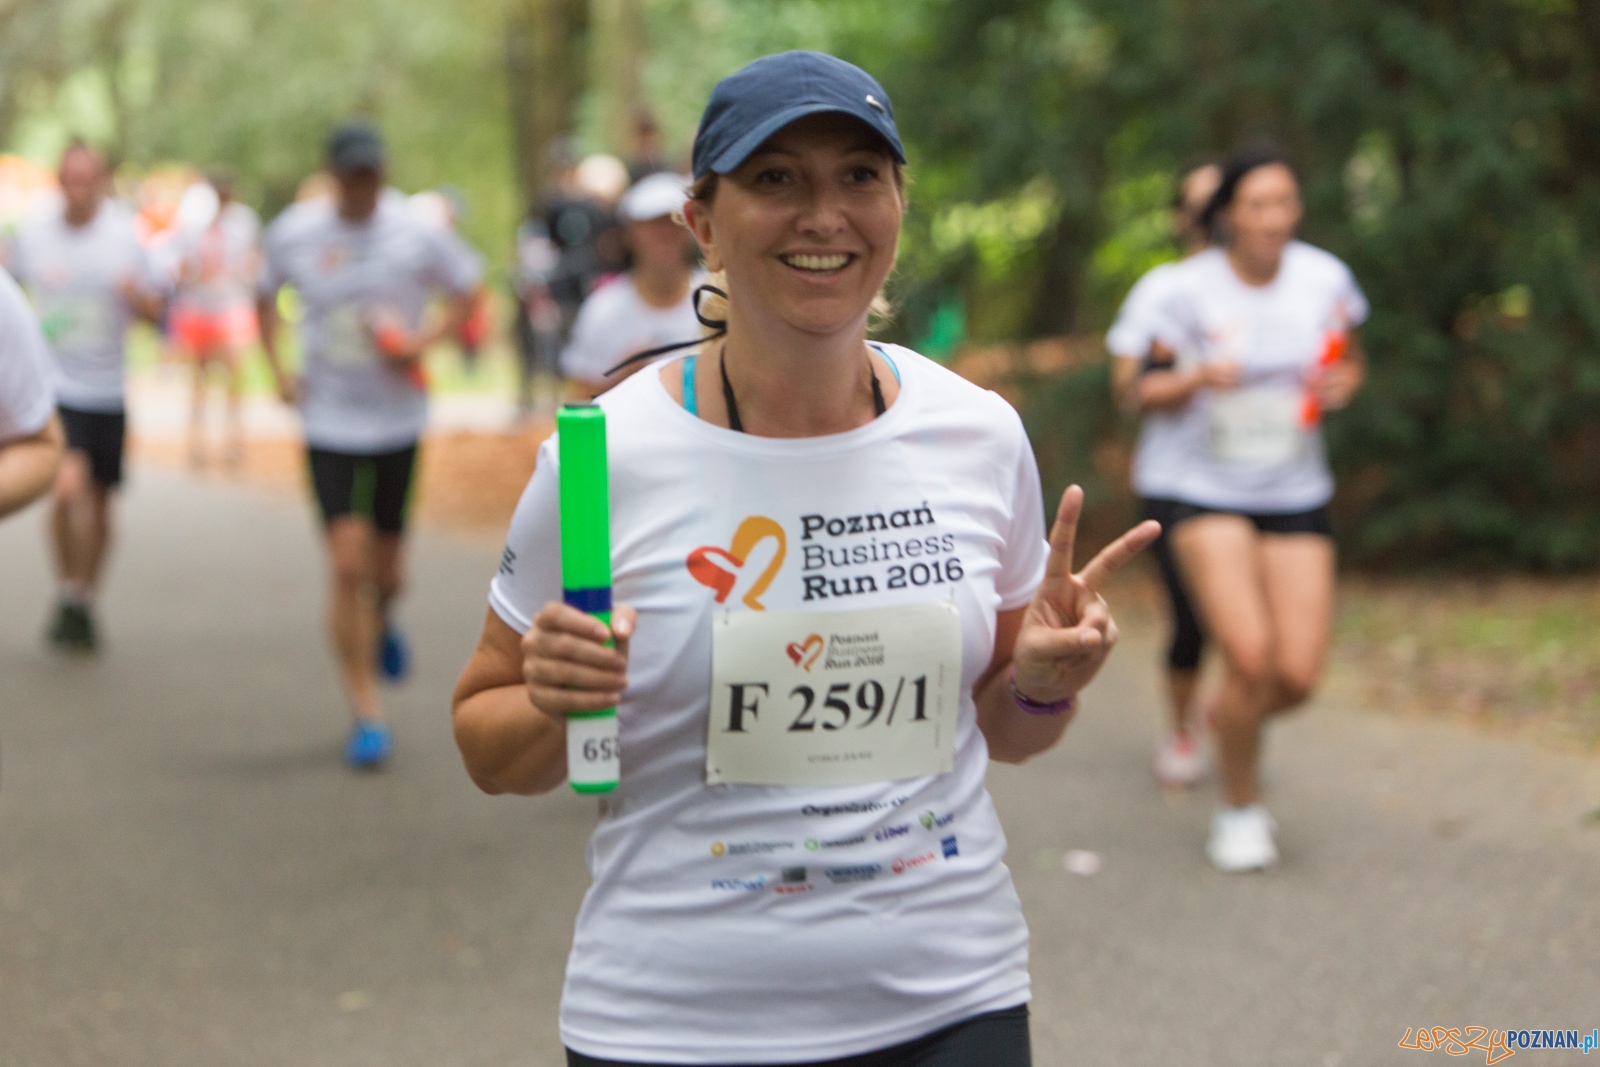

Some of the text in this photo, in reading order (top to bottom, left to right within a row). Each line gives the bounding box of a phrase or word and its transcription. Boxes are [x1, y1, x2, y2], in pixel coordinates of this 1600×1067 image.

[800, 501, 935, 540] Poznań
[801, 533, 955, 571] Business
[802, 557, 964, 601] Run 2016
[722, 682, 770, 734] F
[786, 674, 930, 732] 259/1
